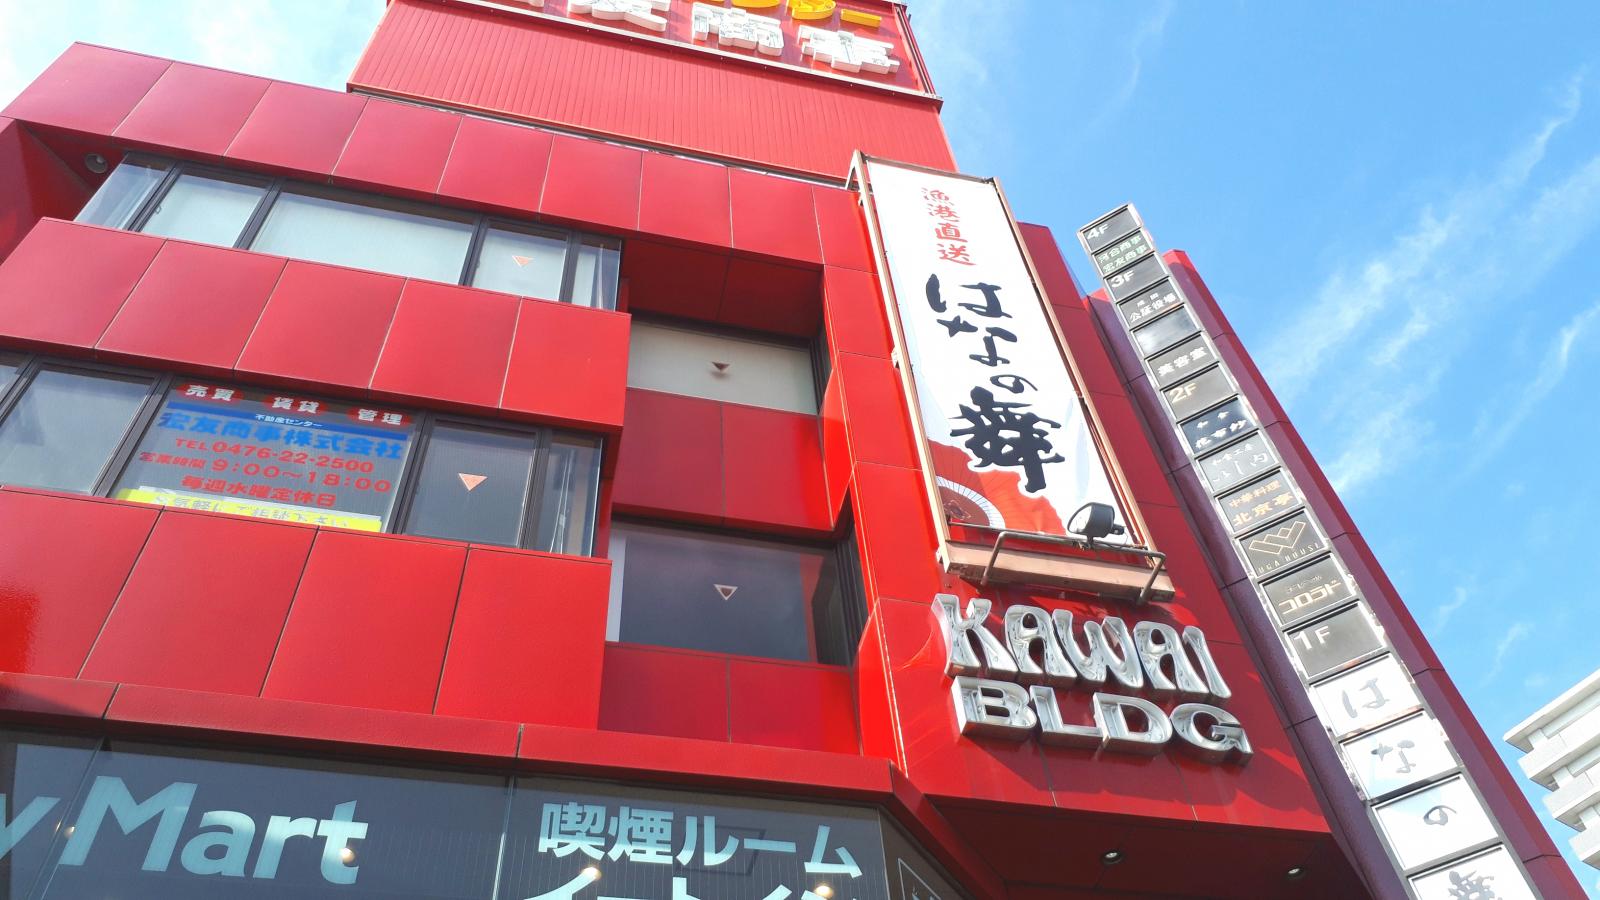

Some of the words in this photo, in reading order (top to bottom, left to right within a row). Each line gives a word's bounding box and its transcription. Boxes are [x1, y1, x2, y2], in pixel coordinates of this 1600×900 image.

[921, 187, 976, 265] 漁港直送
[1087, 223, 1109, 240] 4F
[1110, 270, 1135, 288] 3F
[1157, 347, 1207, 377] 美容室
[185, 385, 234, 401] 売買
[925, 273, 1066, 494] はなの舞
[1169, 383, 1197, 404] 2F
[255, 413, 323, 427] 不動産センター
[272, 396, 319, 414] 賃貸
[358, 408, 403, 425] 管理
[158, 411, 403, 460] 宏友商事株式会社
[175, 437, 208, 451] TEL
[212, 441, 374, 473] 0476-22-2500
[181, 475, 337, 508] 毎週水曜定休日
[1229, 480, 1281, 508] 中華料理
[1279, 579, 1342, 615] コロラド
[931, 593, 1232, 700] KAWAI
[1293, 625, 1331, 650] 1F
[951, 675, 1255, 760] BLDG
[537, 801, 862, 879] 喫煙ルーム
